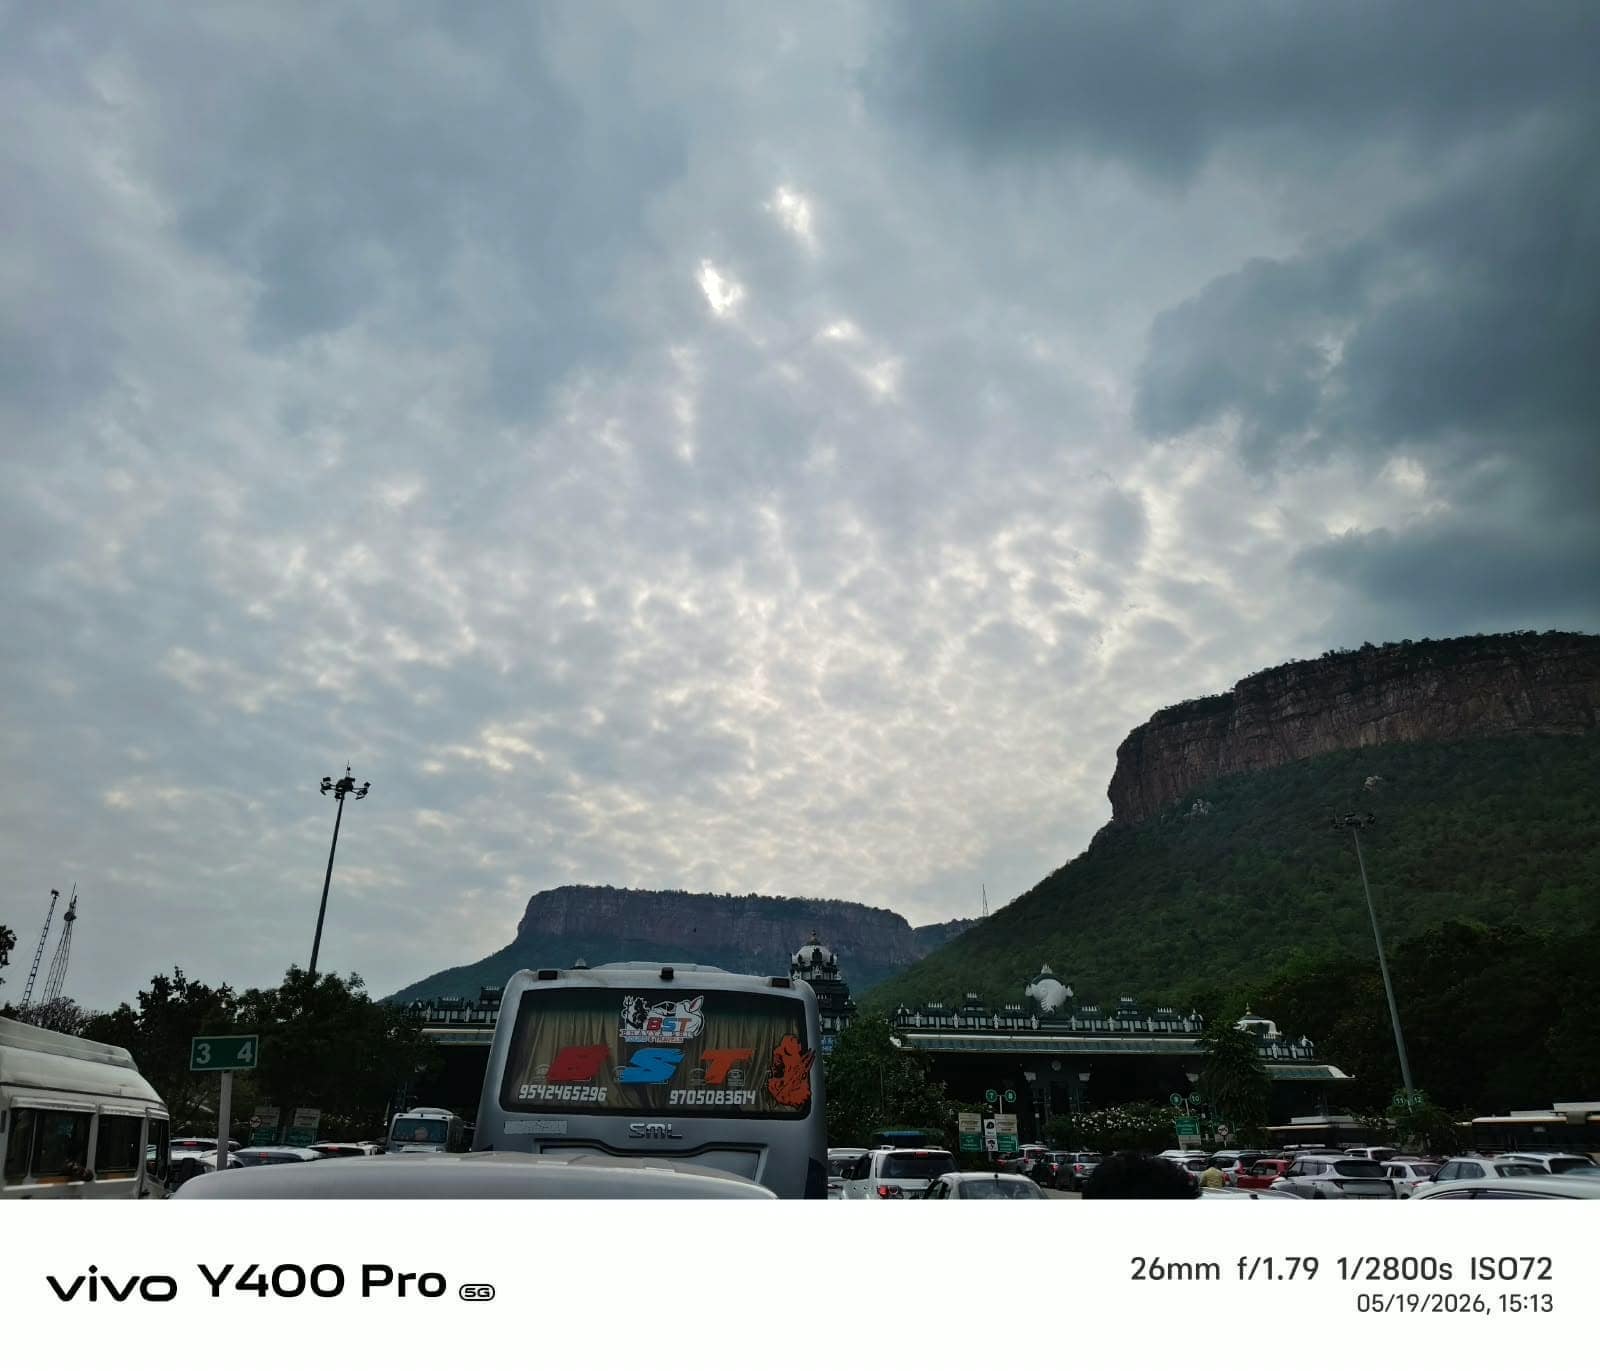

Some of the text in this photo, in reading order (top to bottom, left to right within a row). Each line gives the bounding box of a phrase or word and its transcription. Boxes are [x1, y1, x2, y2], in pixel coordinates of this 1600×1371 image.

[647, 1017, 692, 1033] BST
[196, 1041, 252, 1064] 3 4
[519, 1084, 608, 1102] 9542465296
[669, 1089, 756, 1105] 9705083614
[629, 1123, 682, 1139] SML
